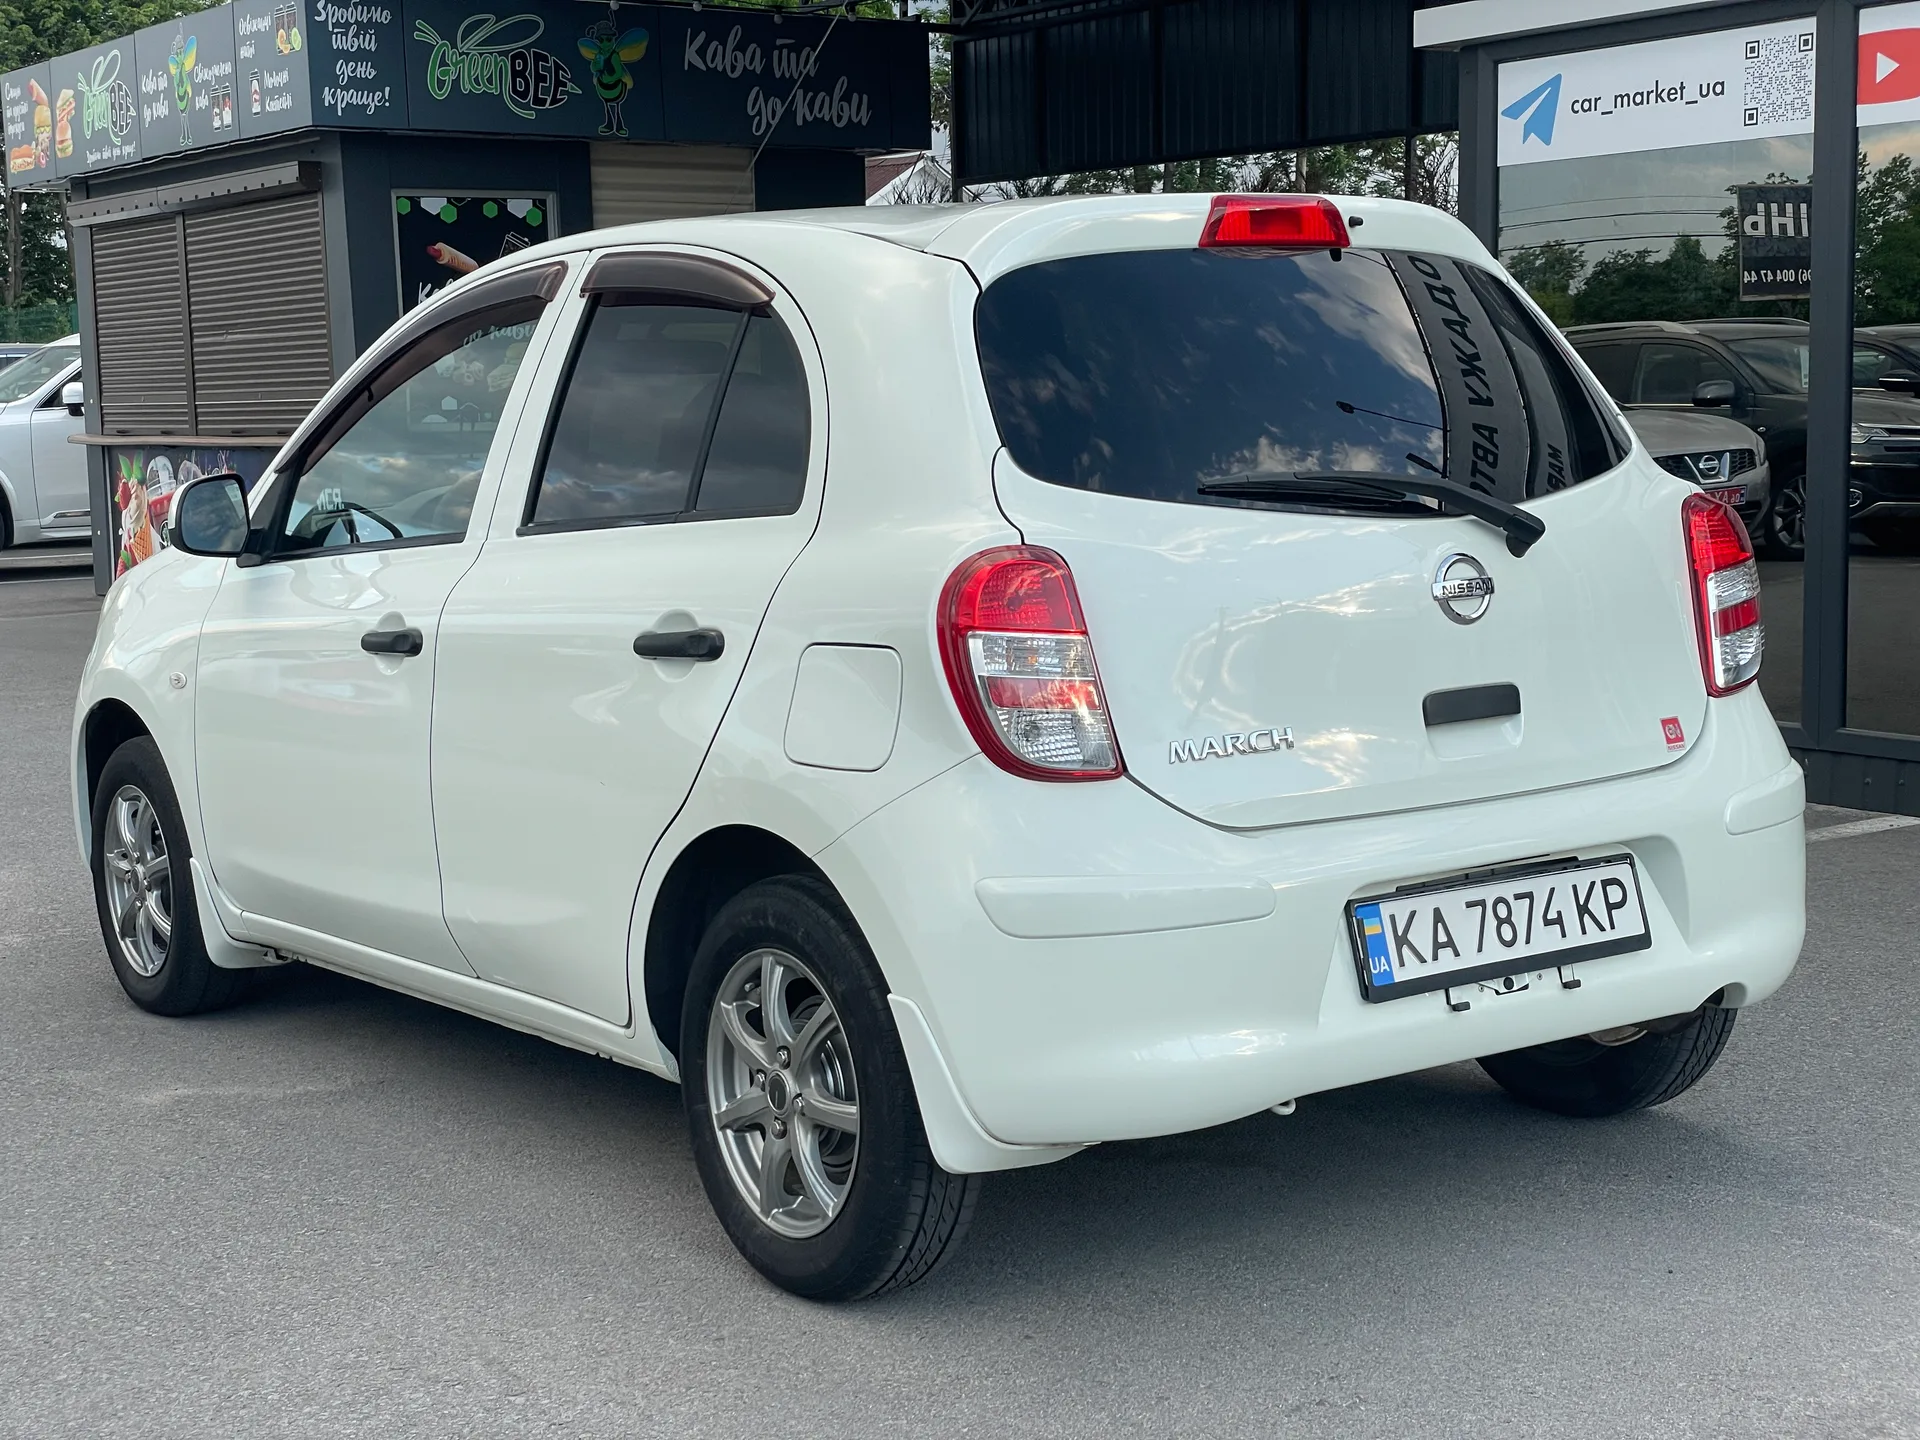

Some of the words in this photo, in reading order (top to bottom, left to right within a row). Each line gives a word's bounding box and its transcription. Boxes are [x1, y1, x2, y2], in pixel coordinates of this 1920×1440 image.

[331, 24, 378, 53] твій
[683, 24, 766, 80] Кава
[772, 38, 821, 80] та
[142, 68, 157, 95] Кава
[335, 59, 377, 86] день
[321, 85, 391, 117] краще!
[747, 85, 784, 136] до
[792, 75, 872, 128] кави
[1570, 77, 1727, 118] car_market_ua
[1440, 577, 1494, 597] NISSAN
[1168, 726, 1295, 764] MARCH
[1388, 906, 1462, 968] KA
[1464, 886, 1568, 954] 7874
[1571, 876, 1629, 936] KP
[1368, 957, 1391, 975] UA
